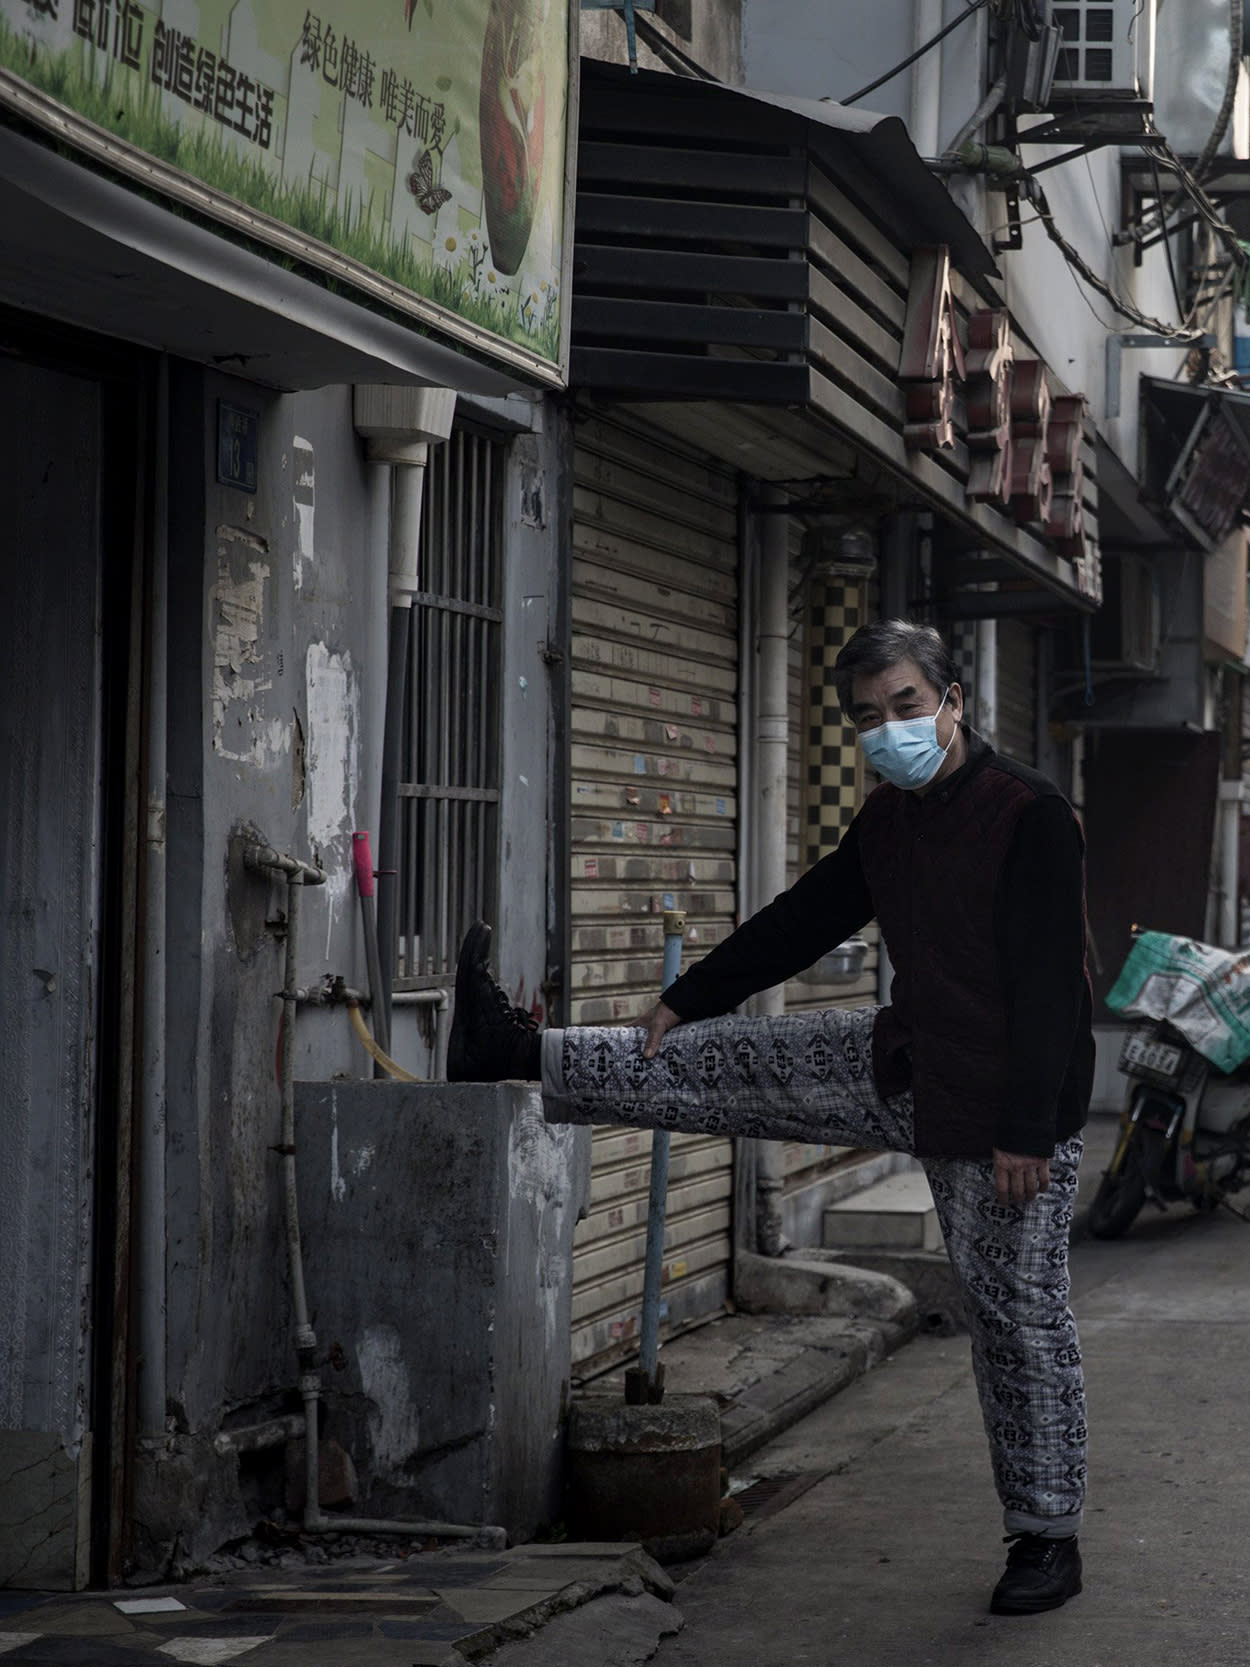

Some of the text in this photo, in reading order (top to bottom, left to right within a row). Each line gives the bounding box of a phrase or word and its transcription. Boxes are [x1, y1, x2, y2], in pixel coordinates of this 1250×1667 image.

[151, 20, 275, 150] 创造绿色生活
[300, 9, 377, 108] 绿色健康
